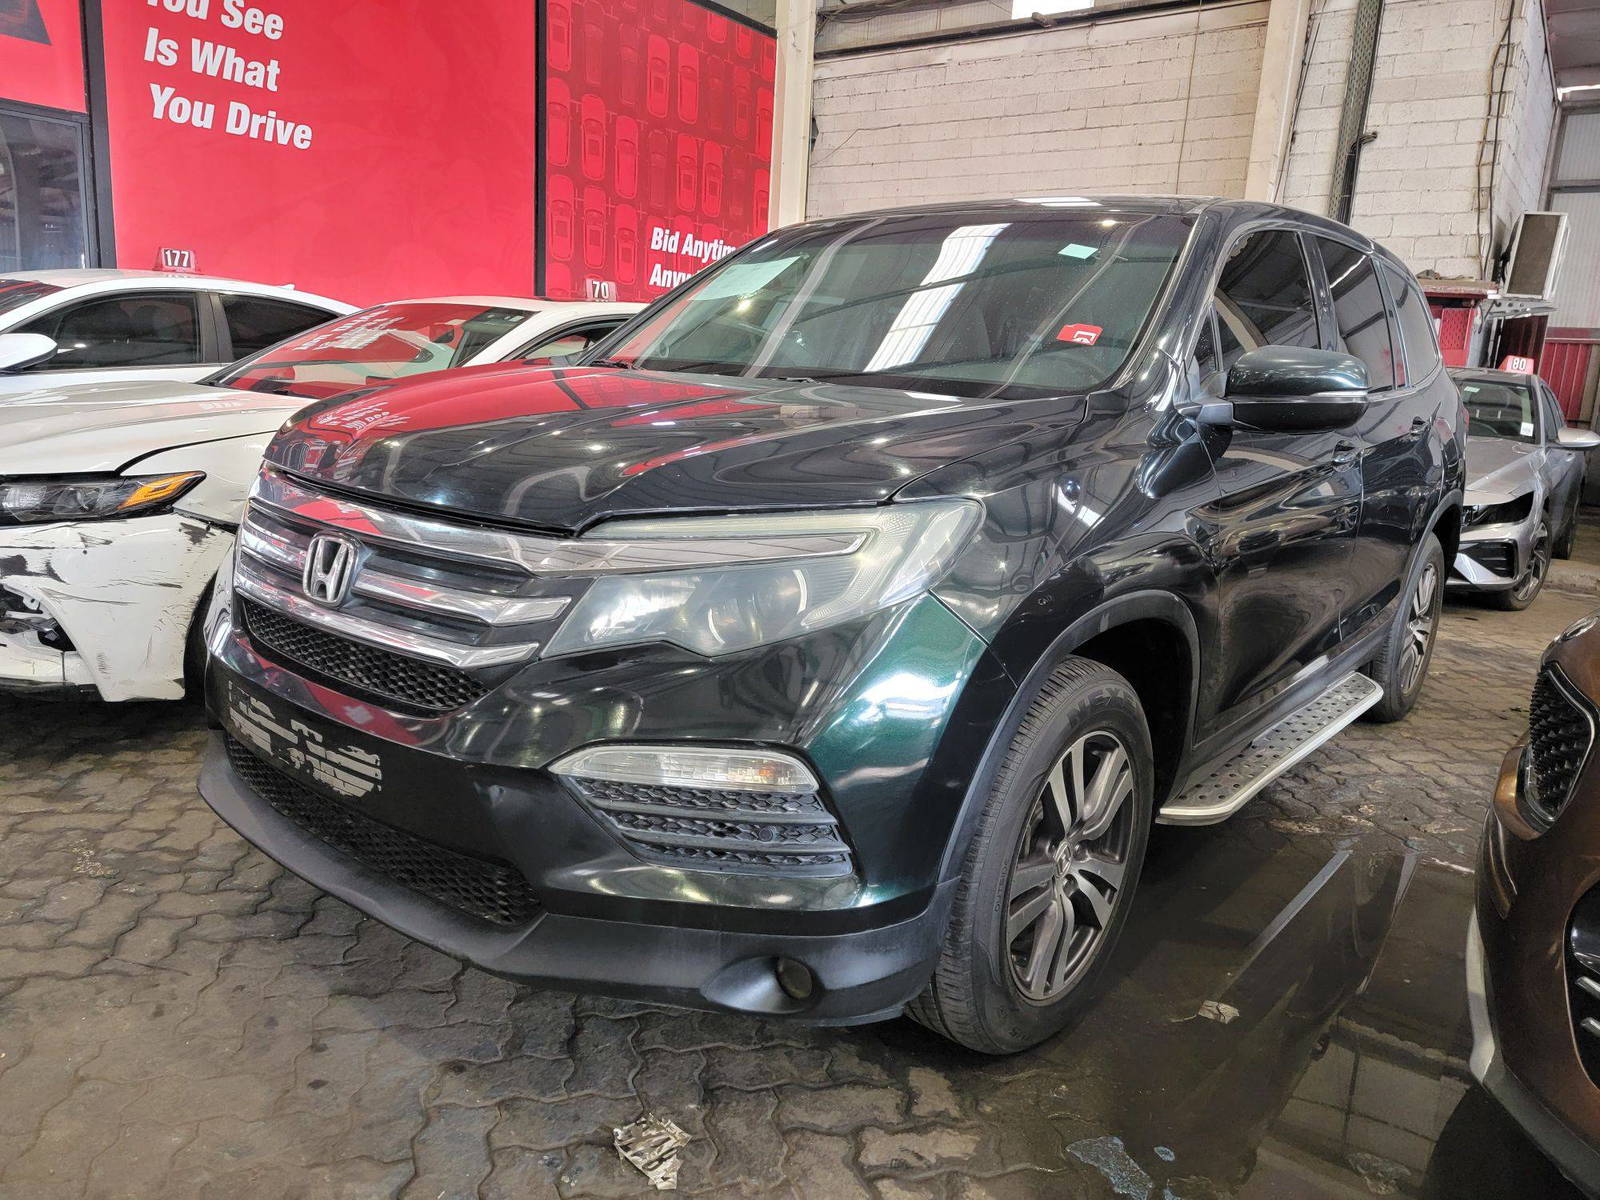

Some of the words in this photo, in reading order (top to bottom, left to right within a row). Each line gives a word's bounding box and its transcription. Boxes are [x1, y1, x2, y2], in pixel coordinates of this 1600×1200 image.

[147, 0, 209, 20] ou
[220, 0, 284, 40] See
[144, 27, 179, 66] Is
[191, 38, 280, 92] What
[149, 83, 215, 129] You
[225, 101, 313, 149] Drive
[651, 227, 680, 254] Bid
[165, 249, 190, 267] 177
[592, 280, 609, 299] 70
[1512, 357, 1526, 371] 80
